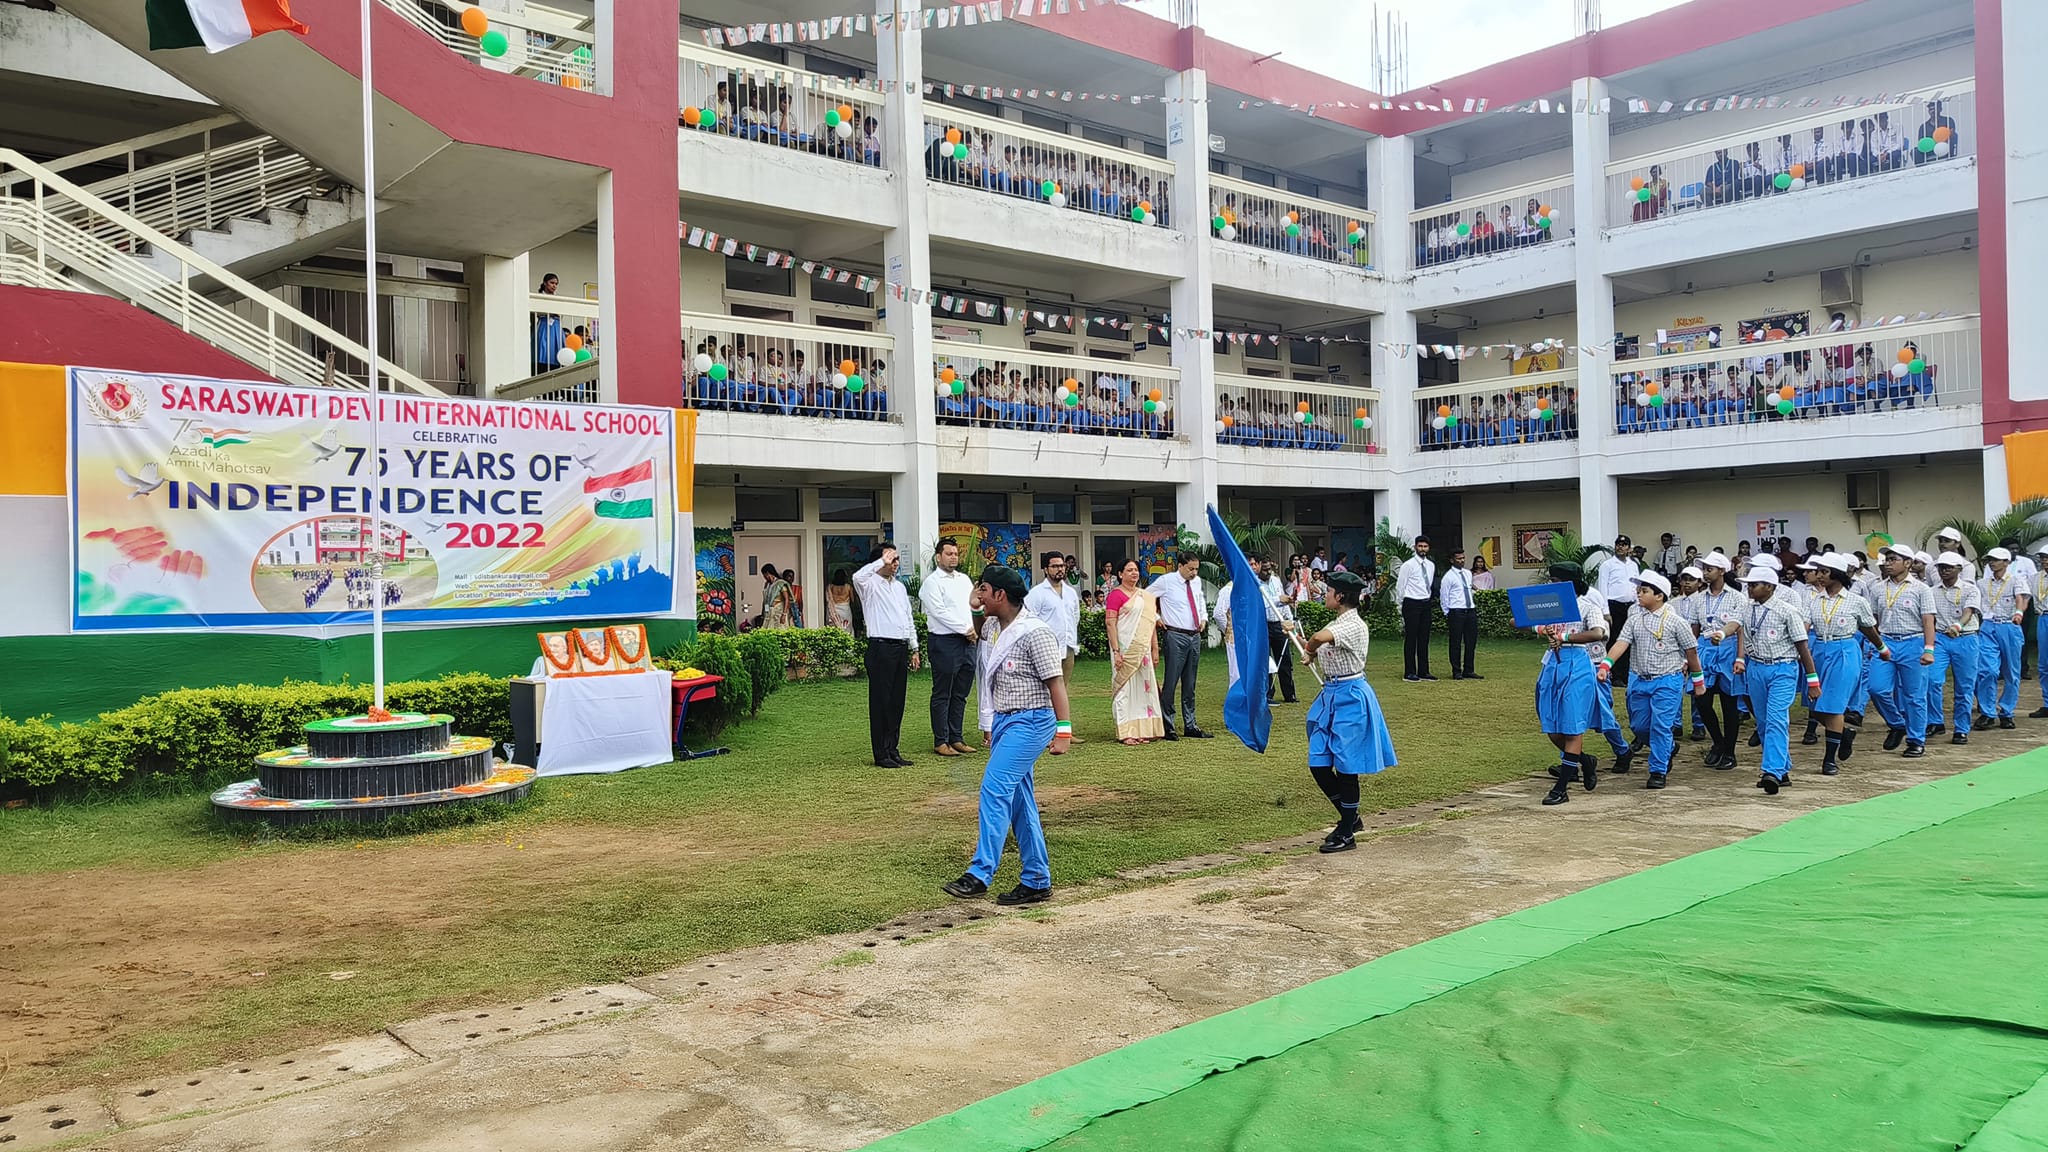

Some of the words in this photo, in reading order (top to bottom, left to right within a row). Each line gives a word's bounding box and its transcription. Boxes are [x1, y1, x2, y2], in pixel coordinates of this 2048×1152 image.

[161, 383, 317, 418] SARASWATI
[395, 400, 577, 432] INTERNATIONAL
[583, 411, 663, 436] SCHOOL
[412, 430, 498, 445] CELEBRATING
[166, 457, 200, 469] Amrit
[202, 461, 272, 474] Mahotsav
[169, 445, 212, 457] Azadi
[215, 452, 230, 462] Ka
[404, 449, 515, 481] YEARS
[529, 455, 572, 482] OF
[168, 480, 543, 516] INDEPENDENCE
[445, 522, 546, 548] 2022
